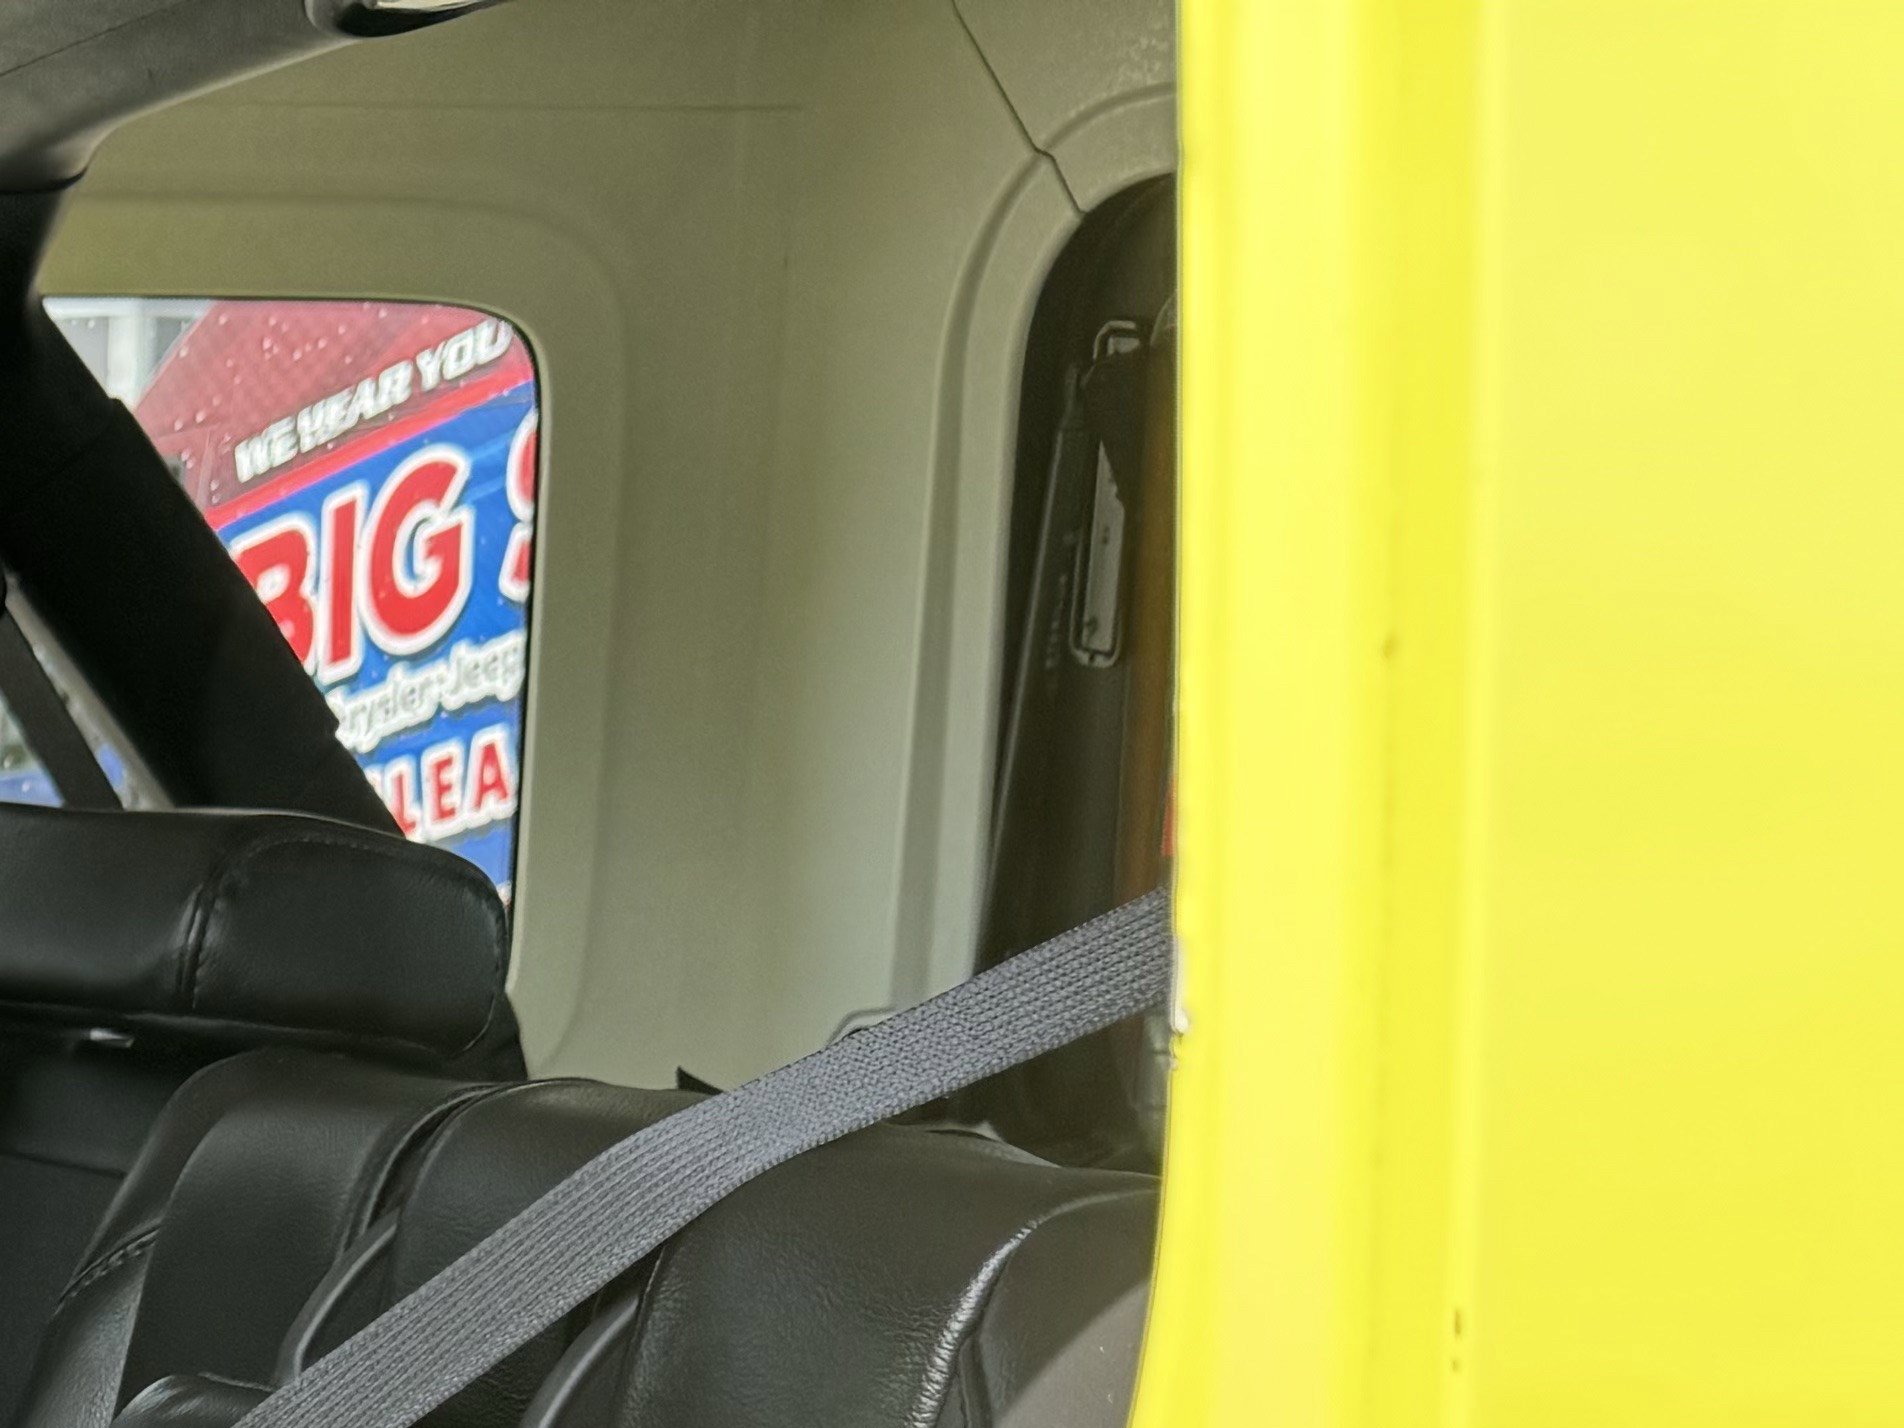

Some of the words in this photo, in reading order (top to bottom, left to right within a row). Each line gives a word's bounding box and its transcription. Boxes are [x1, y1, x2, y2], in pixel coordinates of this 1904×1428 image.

[235, 415, 299, 484] WE
[296, 359, 414, 454] HEAR
[229, 444, 474, 685] BIG
